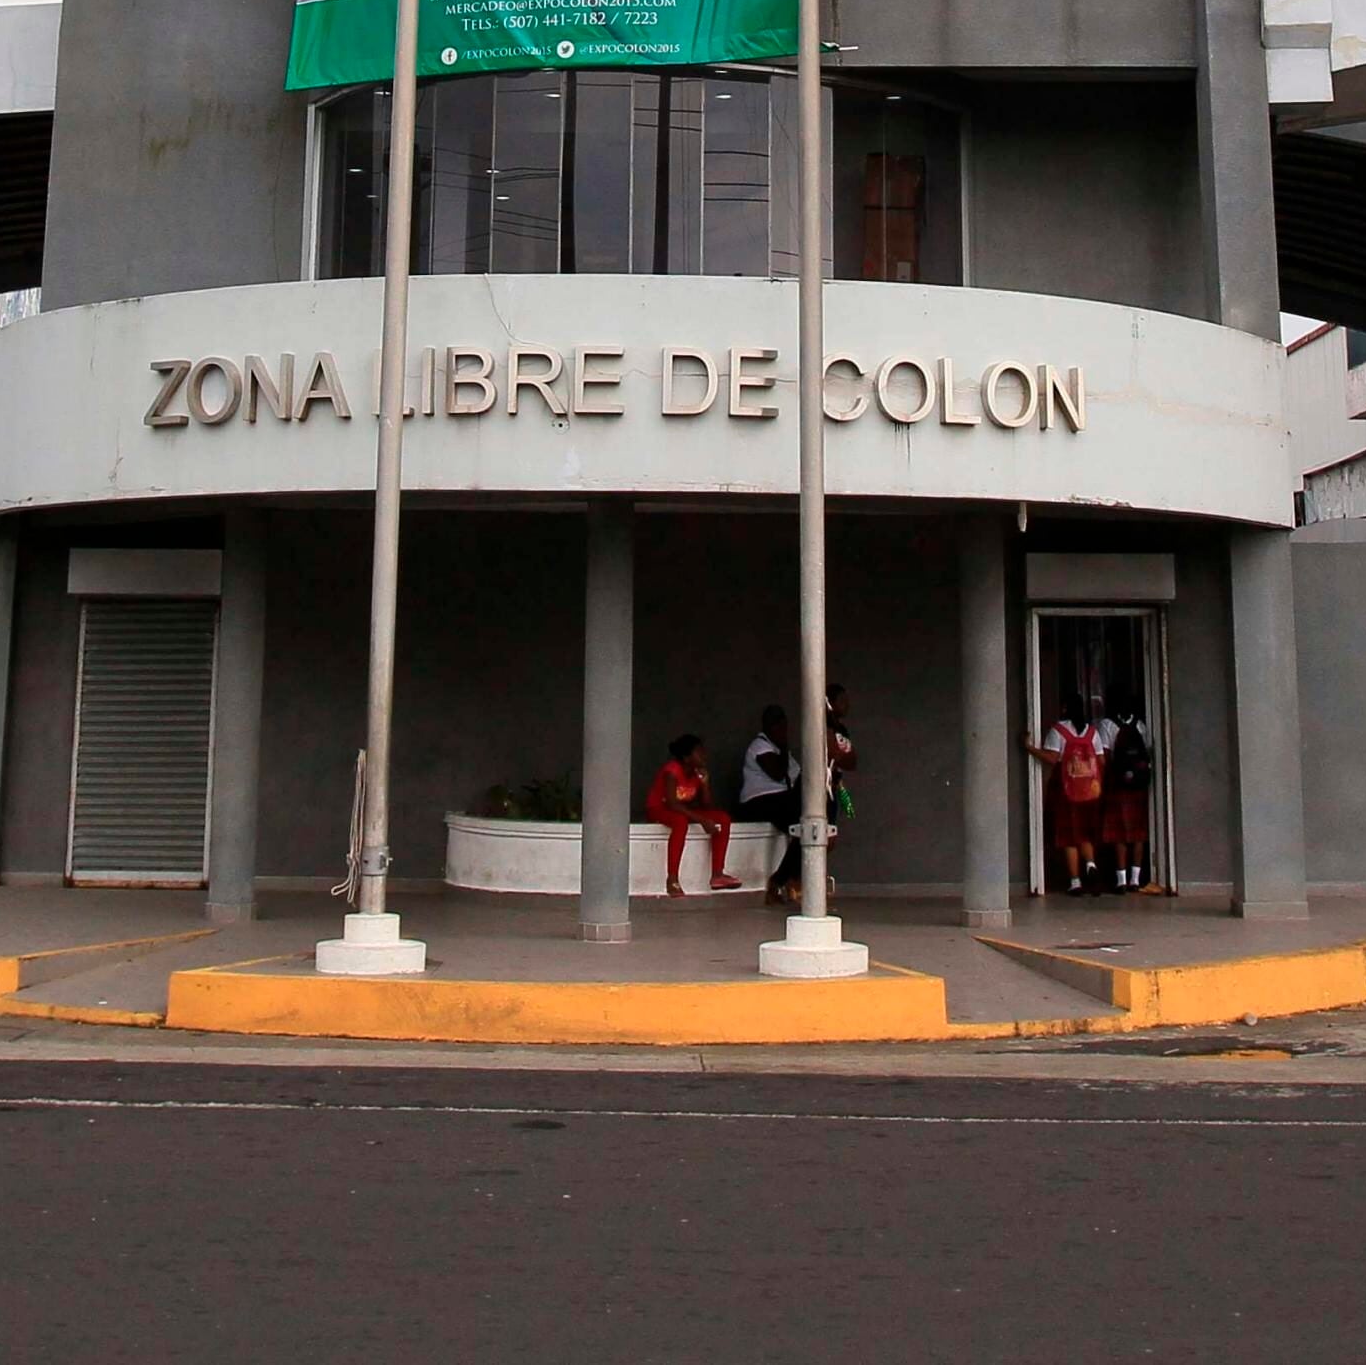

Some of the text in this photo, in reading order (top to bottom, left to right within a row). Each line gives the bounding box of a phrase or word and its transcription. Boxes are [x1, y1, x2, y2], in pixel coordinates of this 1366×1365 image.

[503, 14, 539, 30] (507)
[542, 12, 606, 27] 441-7182
[623, 12, 658, 25] 7223
[148, 351, 351, 429] ZONA
[659, 345, 779, 420] DE
[821, 351, 1088, 433] COLON
